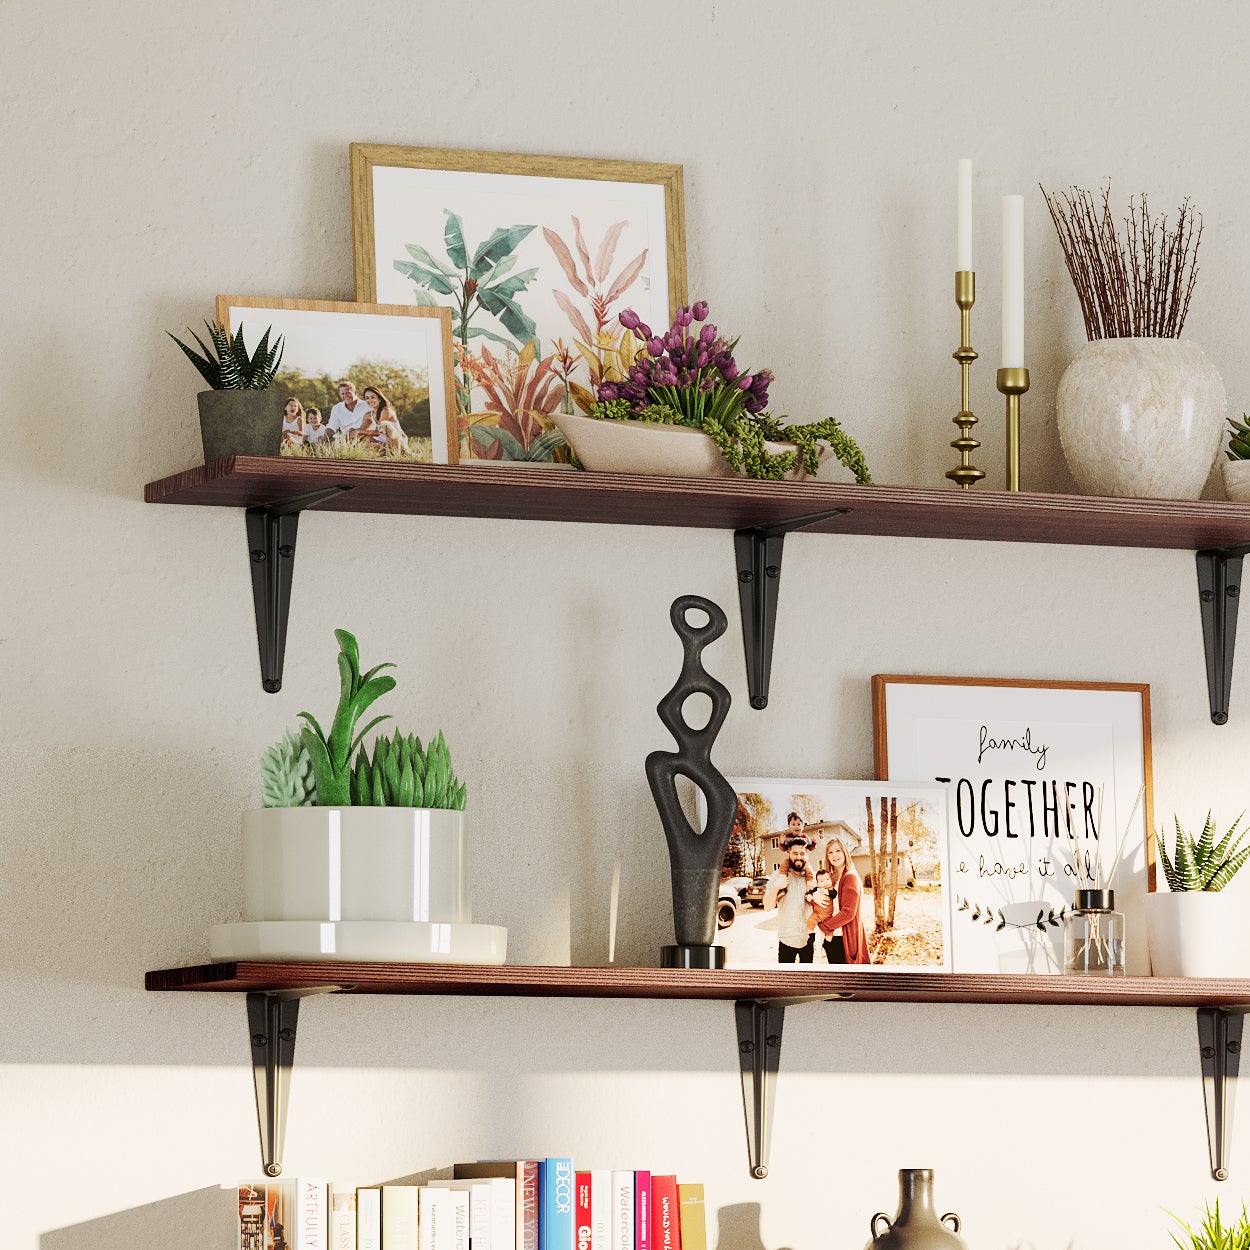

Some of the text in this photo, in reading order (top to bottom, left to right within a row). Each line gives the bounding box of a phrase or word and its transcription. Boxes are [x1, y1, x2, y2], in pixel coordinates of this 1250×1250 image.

[978, 725, 1050, 770] family
[935, 777, 1099, 840] OGETHER
[979, 855, 1028, 879] have
[1038, 857, 1055, 876] it
[520, 1174, 535, 1214] NEW
[556, 1169, 570, 1214] DECOR
[662, 1197, 670, 1228] WOULD
[306, 1183, 318, 1248] ARTFULLY
